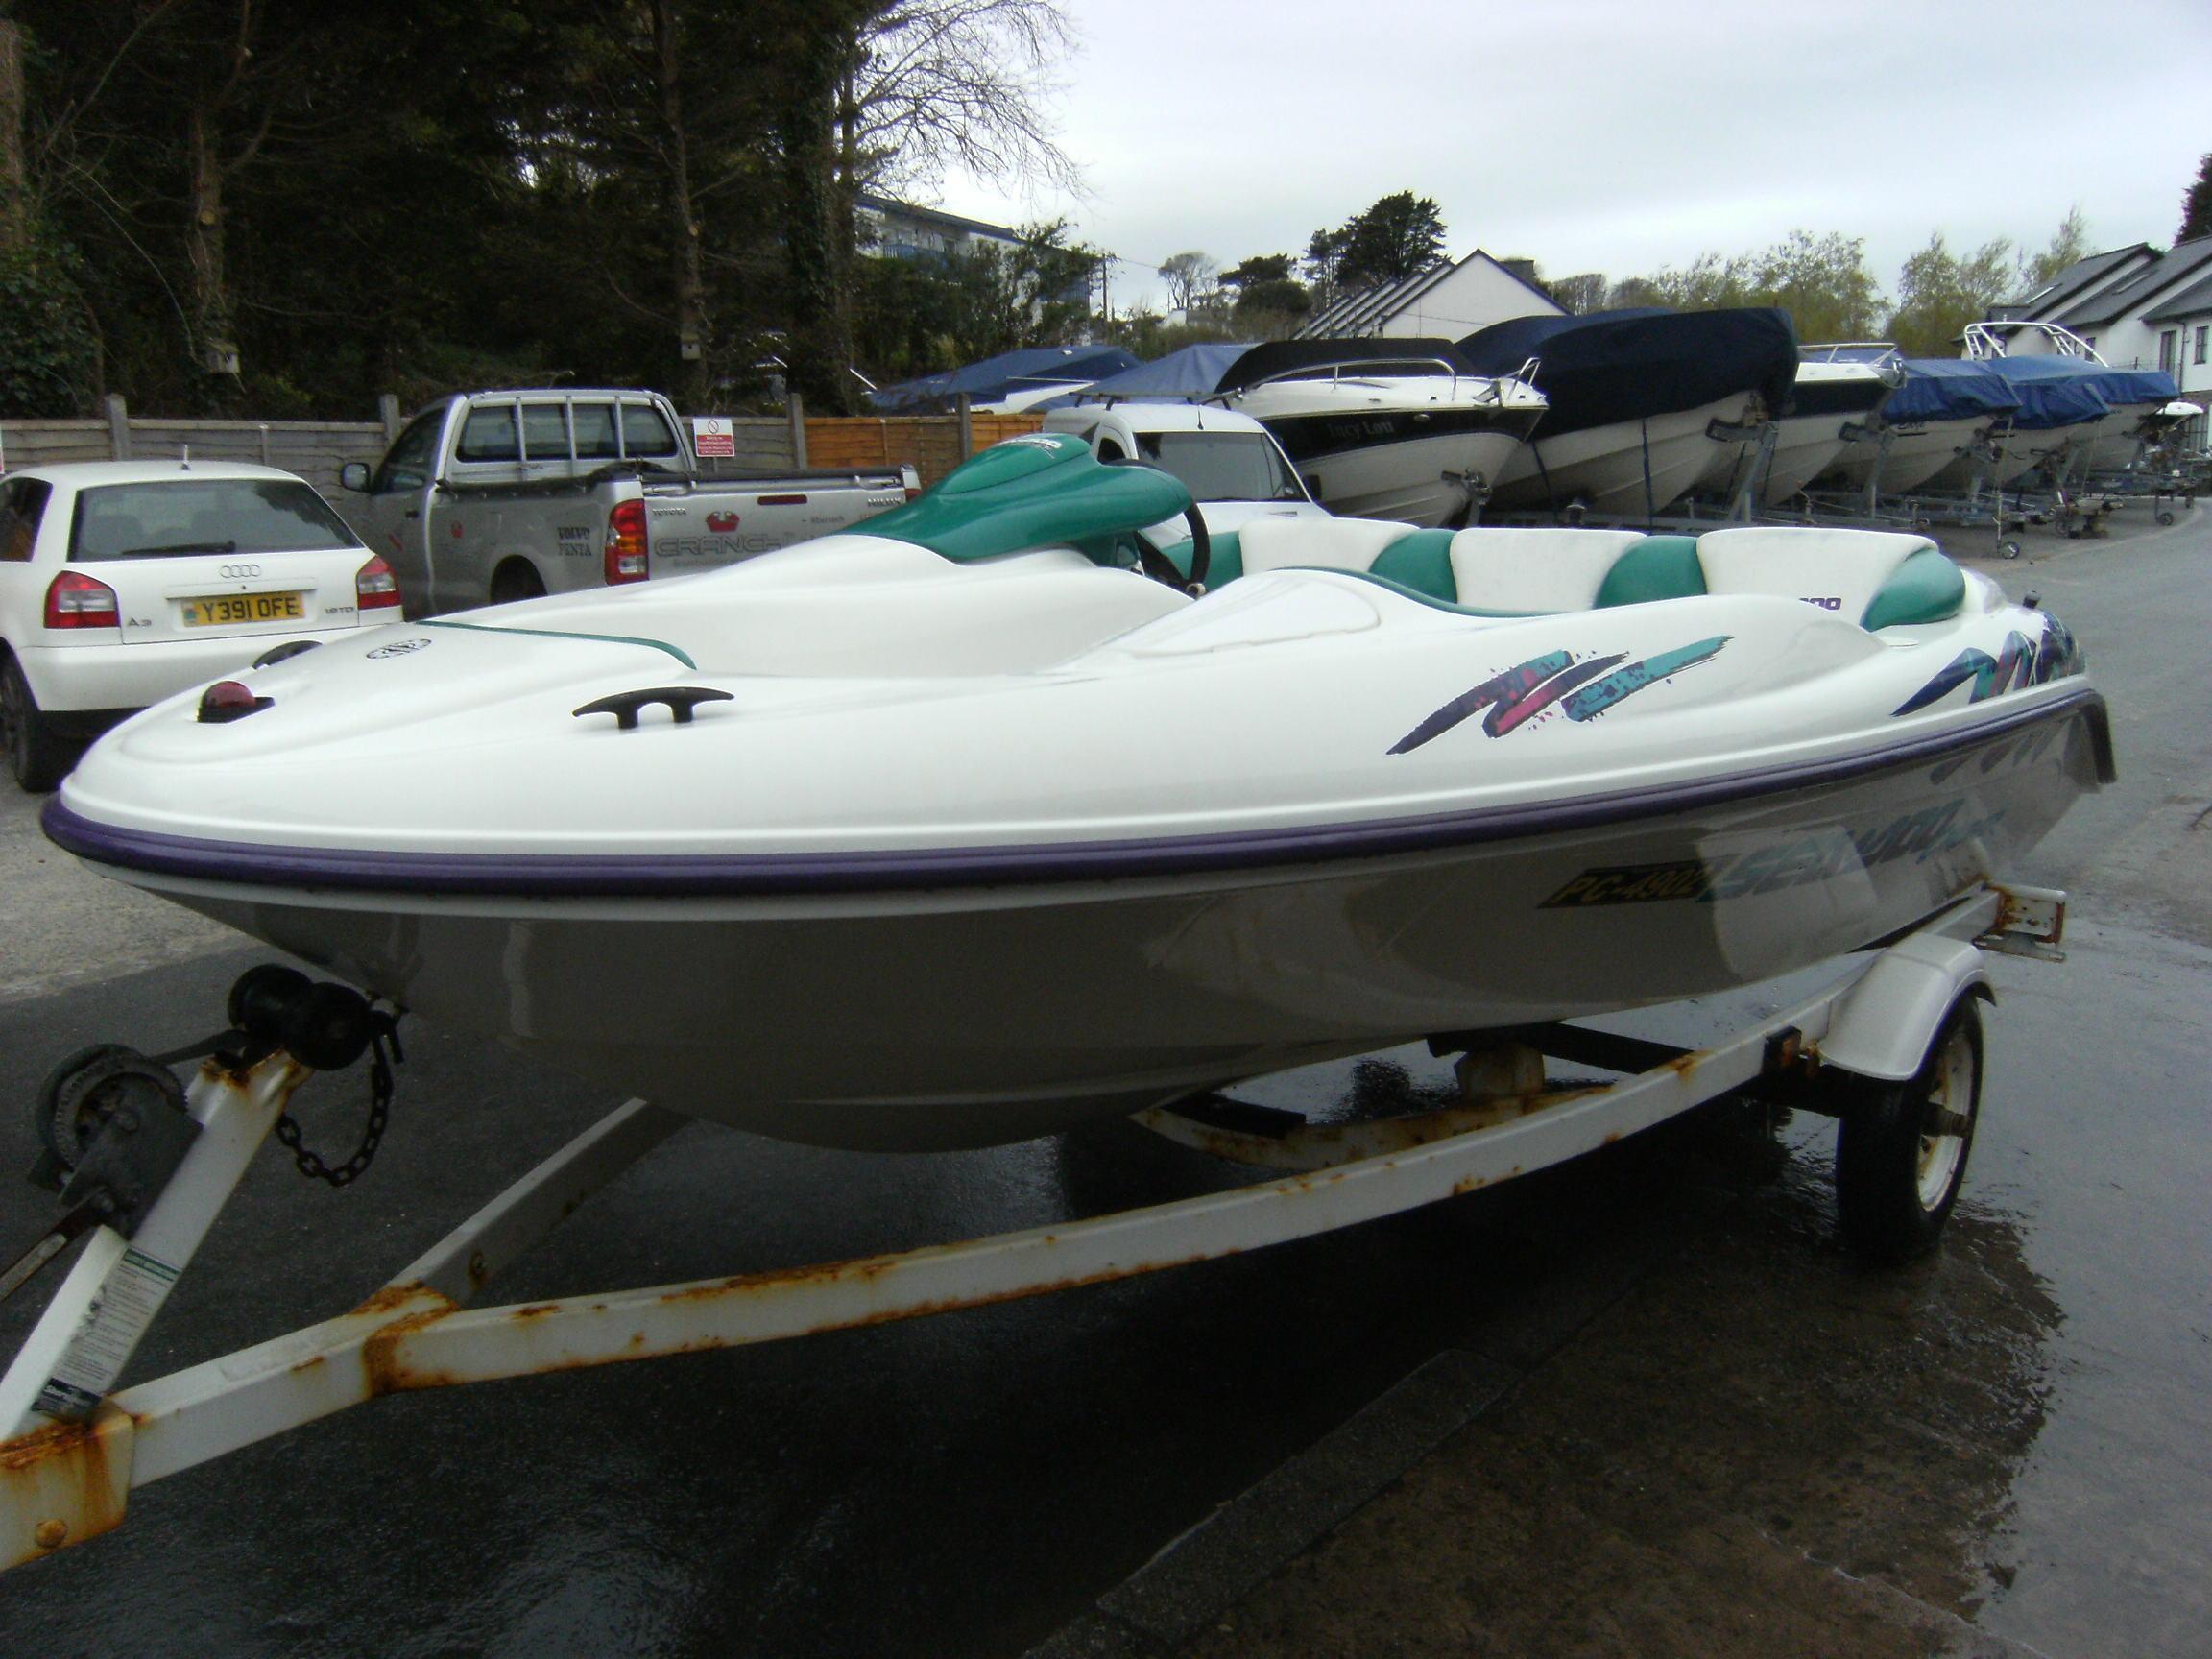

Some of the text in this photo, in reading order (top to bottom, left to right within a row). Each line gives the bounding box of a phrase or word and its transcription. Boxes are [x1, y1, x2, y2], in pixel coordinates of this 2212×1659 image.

[652, 507, 687, 517] TOYOTA
[557, 527, 590, 540] VOLVO
[558, 543, 592, 557] PENTA
[202, 596, 299, 622] Y391 OFE
